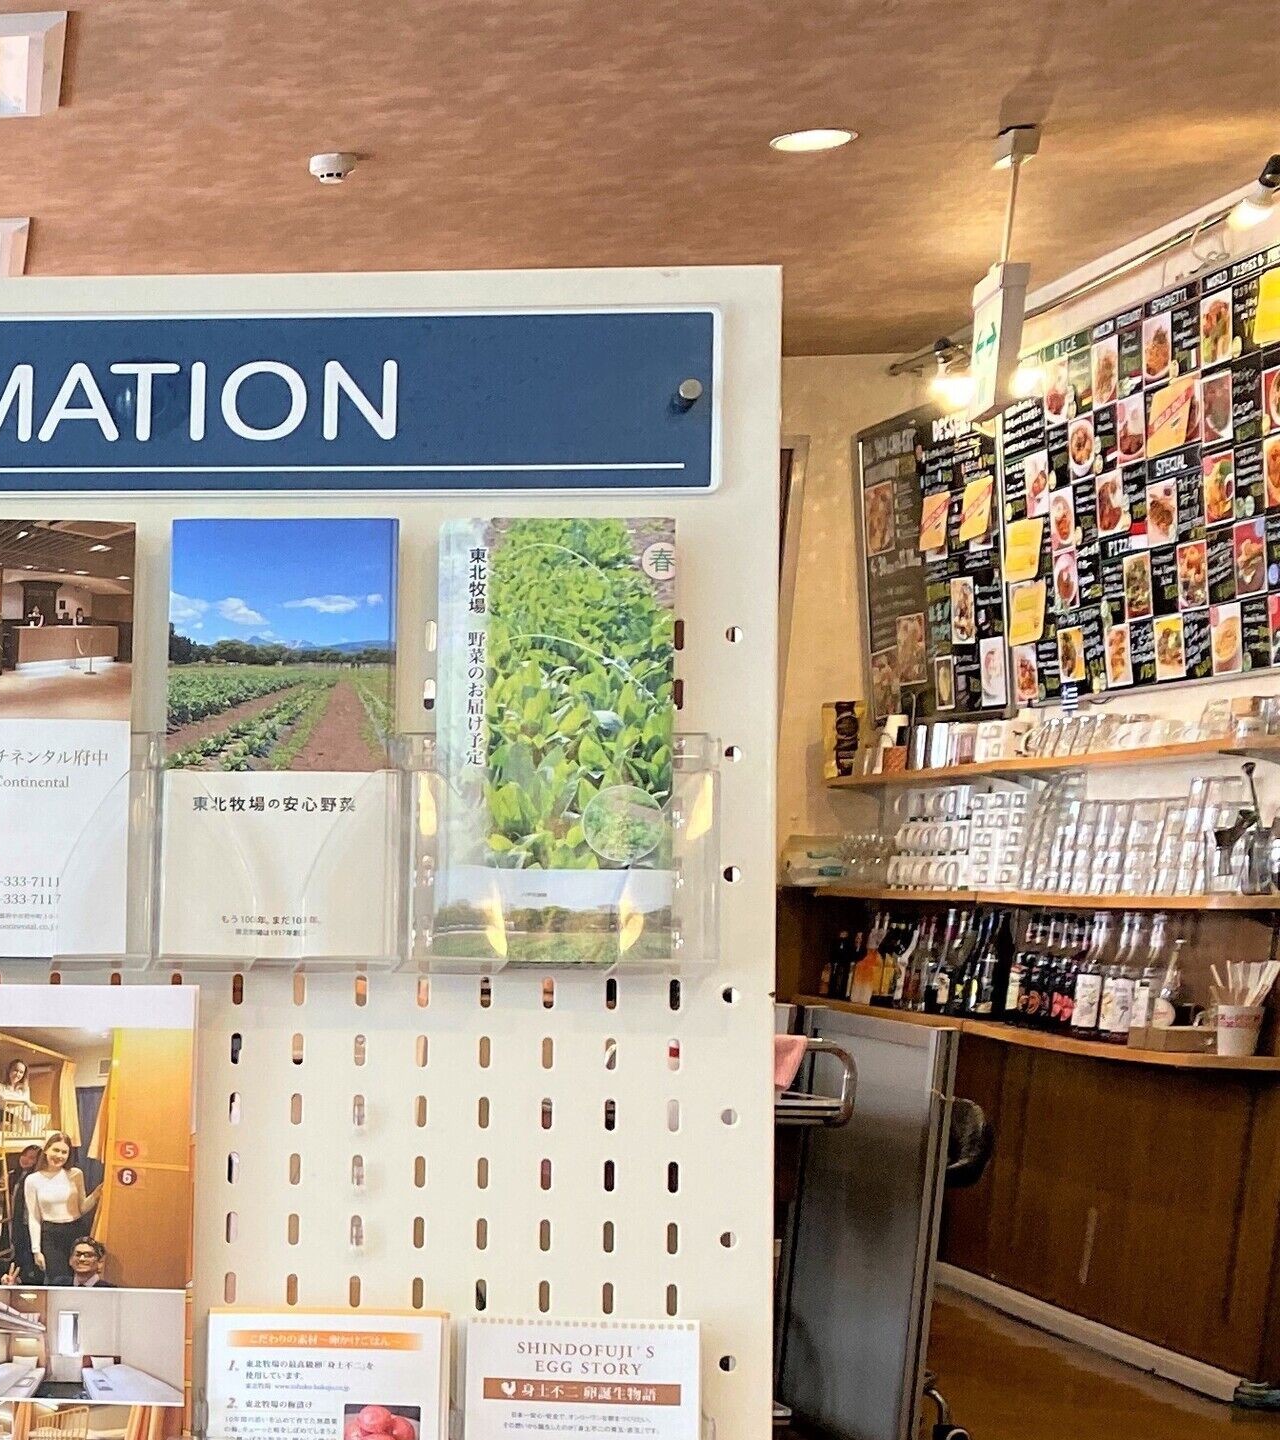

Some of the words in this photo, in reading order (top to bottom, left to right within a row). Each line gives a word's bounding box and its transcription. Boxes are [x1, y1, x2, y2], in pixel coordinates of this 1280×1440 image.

[649, 548, 675, 572] 春
[469, 548, 487, 613] 東北牧場
[466, 631, 486, 765] 野菜のお届け予定
[193, 796, 356, 813] 東北牧場の安心野菜
[124, 1144, 135, 1157] 5
[122, 1169, 133, 1184] 6
[535, 1360, 572, 1373] EGG
[581, 1362, 643, 1376] STORY
